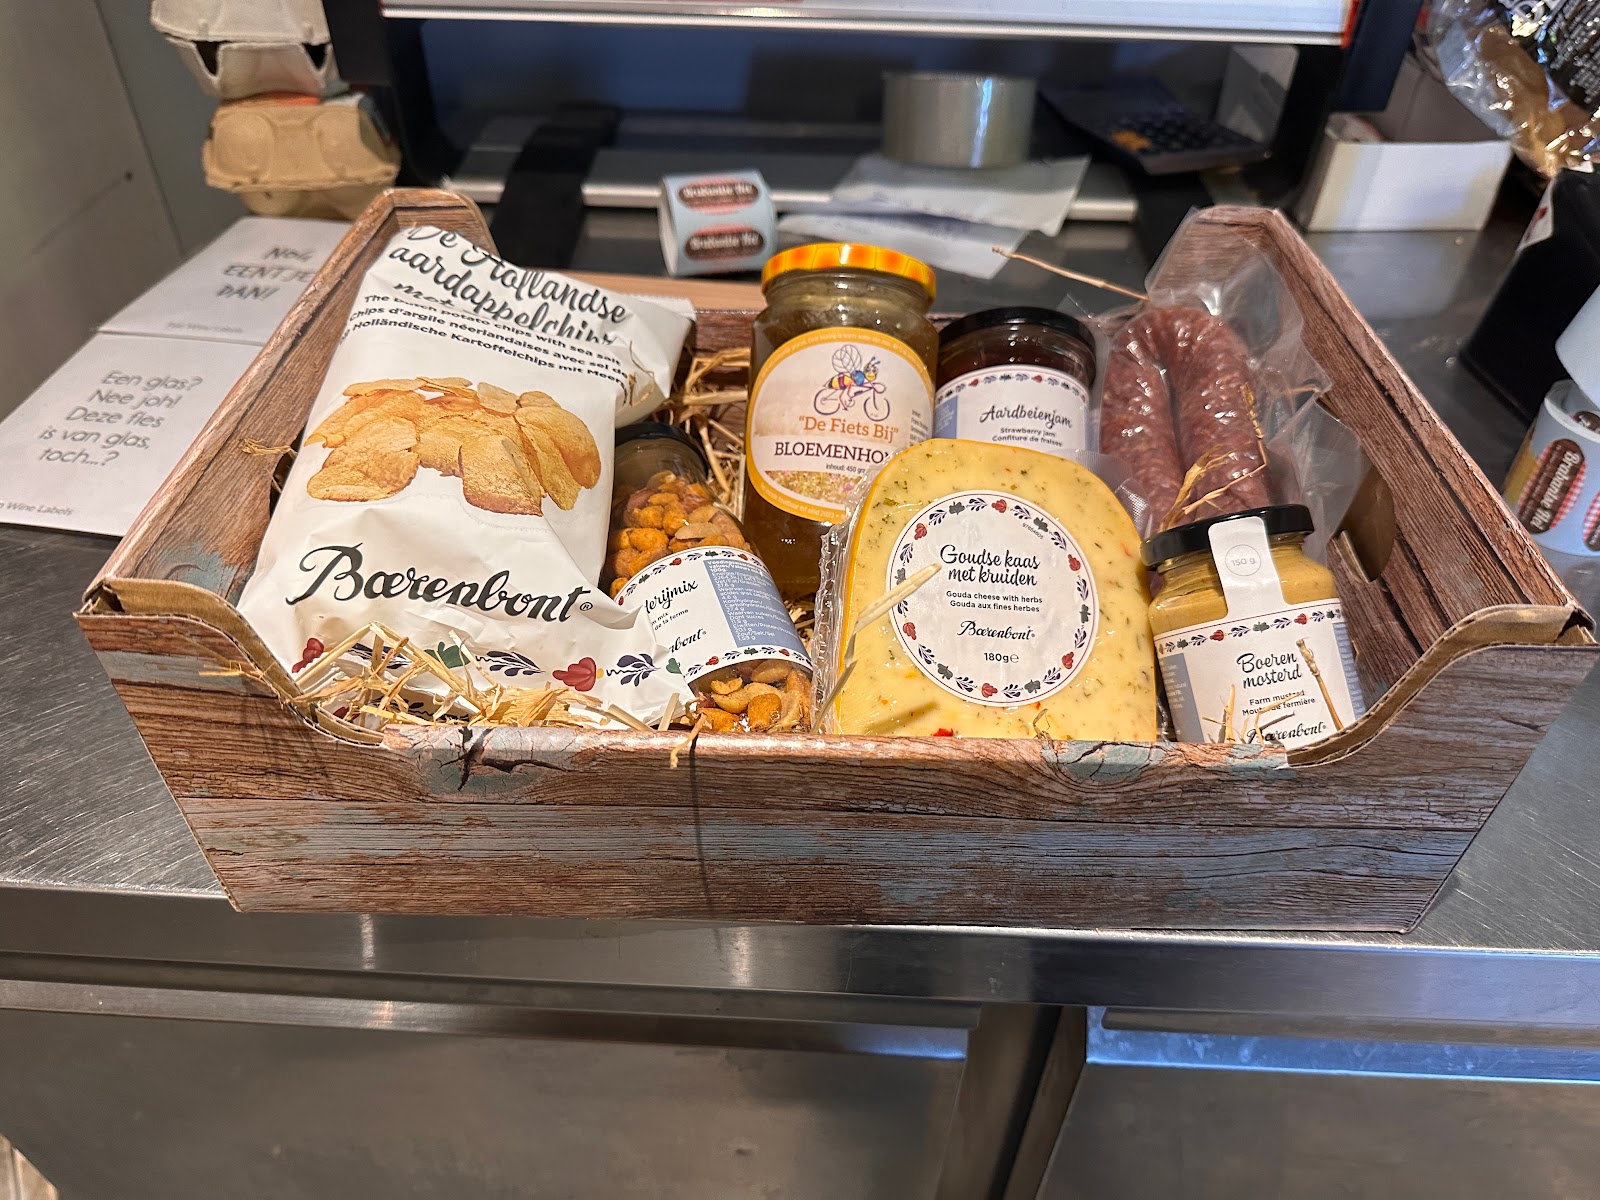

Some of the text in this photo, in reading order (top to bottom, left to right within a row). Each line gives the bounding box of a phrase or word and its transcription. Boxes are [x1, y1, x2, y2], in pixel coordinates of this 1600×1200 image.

[365, 295, 390, 303] The
[441, 309, 490, 326] potato
[494, 323, 532, 338] chips
[536, 335, 567, 348] with
[569, 345, 593, 357] sea
[596, 353, 621, 366] salt
[349, 307, 384, 322] Chips
[449, 321, 550, 354] néerlandaises
[553, 352, 586, 366] avec
[589, 361, 608, 371] sel
[612, 367, 628, 379] de
[352, 318, 447, 337] Holländische
[450, 333, 555, 368] Kartoffelchips
[558, 364, 584, 374] mit
[102, 370, 203, 391] Een glas?
[88, 389, 183, 410] Nee joh!
[66, 405, 165, 428] Deze fles
[830, 418, 869, 436] Fiets
[979, 405, 1072, 429] Aardbeienjam
[39, 425, 150, 449] is van glas,
[1000, 427, 1041, 435] Strawberry
[1040, 437, 1062, 447] fraises
[39, 448, 120, 466] toch...?
[774, 442, 889, 464] BLOEMENHO
[846, 465, 857, 473] 450
[1540, 450, 1580, 508] Brabantse
[7, 502, 36, 512] Wine
[37, 505, 73, 516] Labels
[1530, 507, 1552, 531] Hei
[940, 544, 1040, 569] Goudse kaas
[1231, 557, 1256, 566] 150 g
[948, 565, 1037, 586] met kruiden
[946, 590, 1043, 603] Gouda cheese with herbs
[950, 600, 976, 608] Gouda
[993, 602, 1012, 610] fines
[1013, 604, 1040, 612] herbes
[654, 623, 662, 631] de
[670, 609, 689, 620] ferme
[658, 612, 669, 621] mix
[1236, 653, 1297, 673] Boeren
[1243, 664, 1302, 689] mosterd
[1249, 697, 1271, 705] Farm
[1283, 697, 1315, 709] fermière
